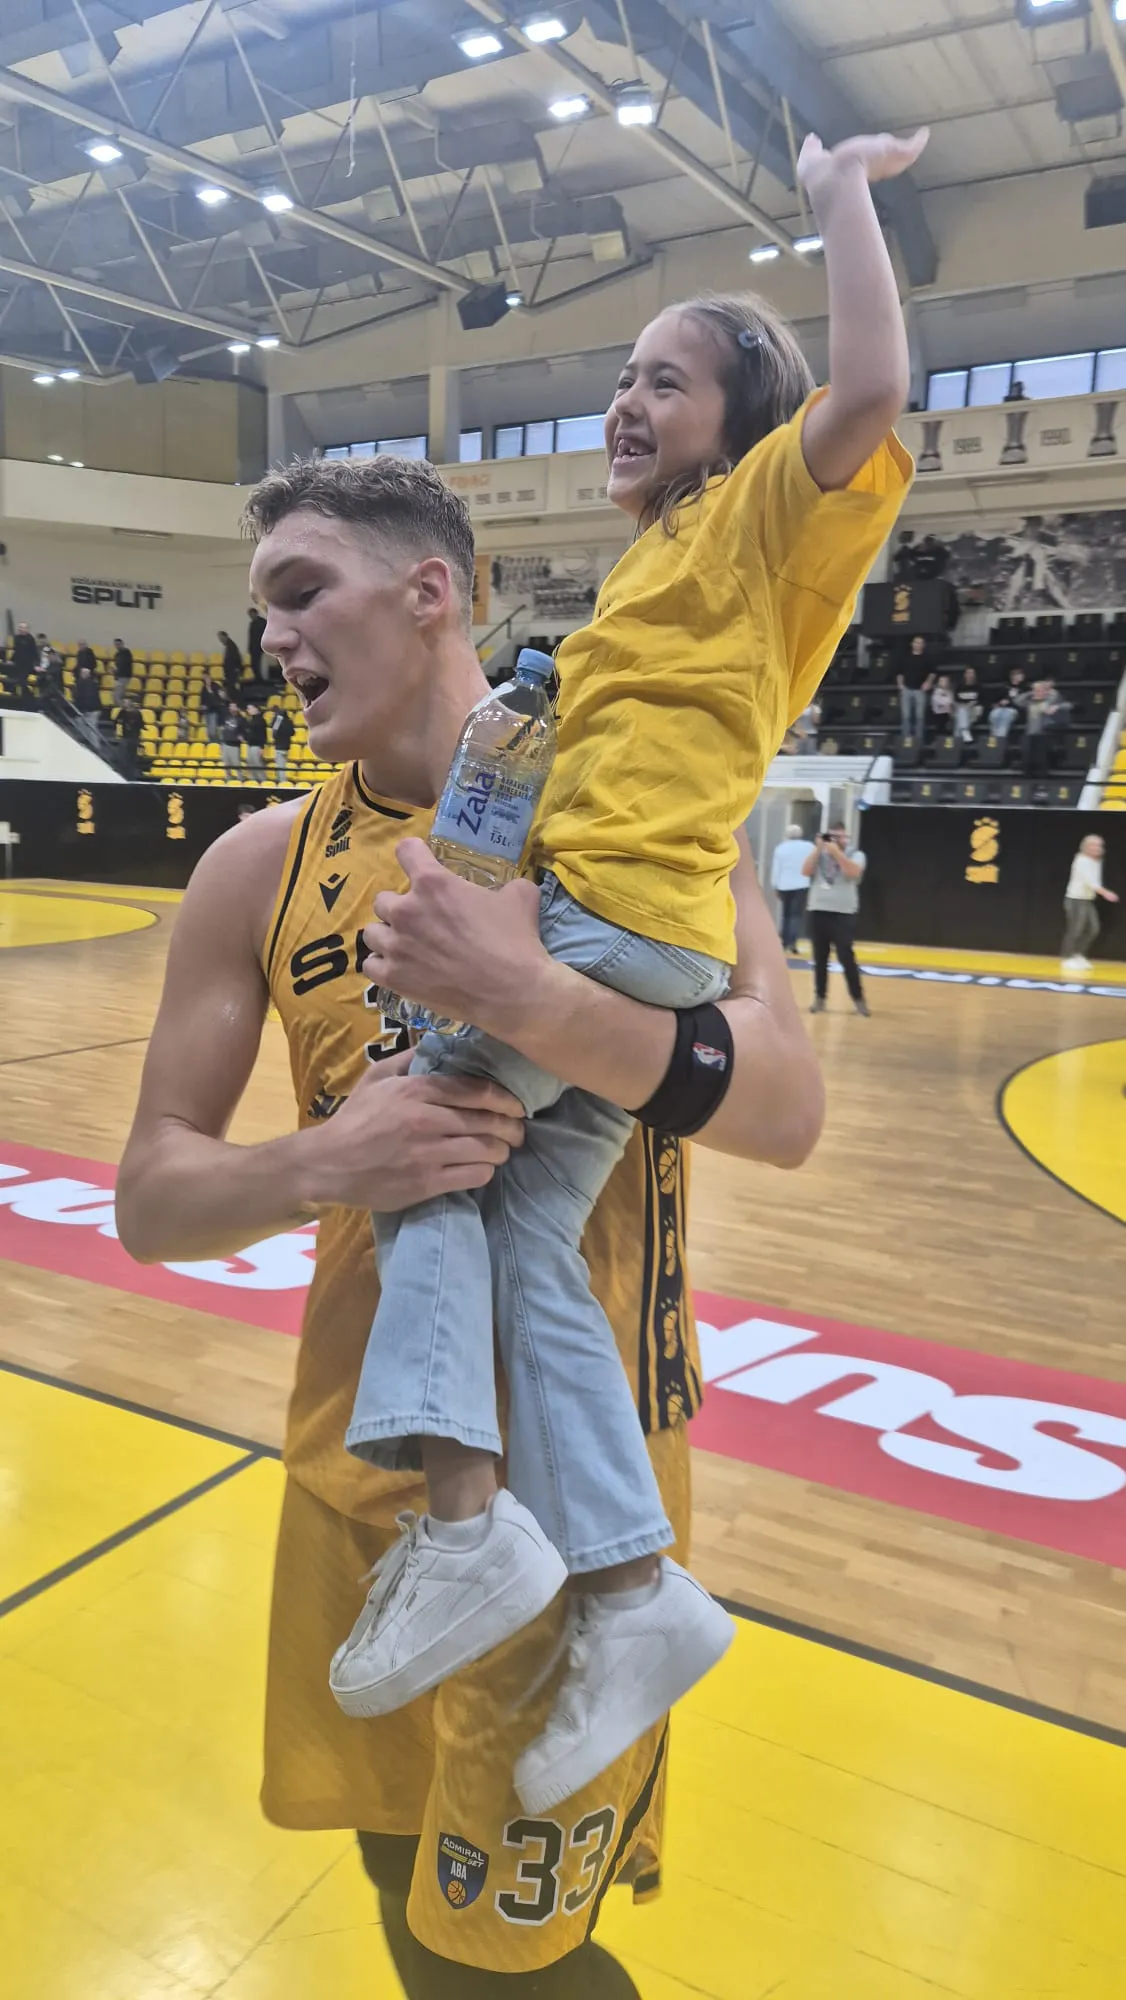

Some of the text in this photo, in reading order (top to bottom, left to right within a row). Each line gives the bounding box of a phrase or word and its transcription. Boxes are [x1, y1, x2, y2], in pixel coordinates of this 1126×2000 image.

[72, 585, 162, 610] SPLIT
[456, 772, 496, 836] Zala
[442, 1837, 484, 1862] ADMIRAL
[451, 1860, 467, 1880] ABA
[494, 1804, 617, 1926] 33
